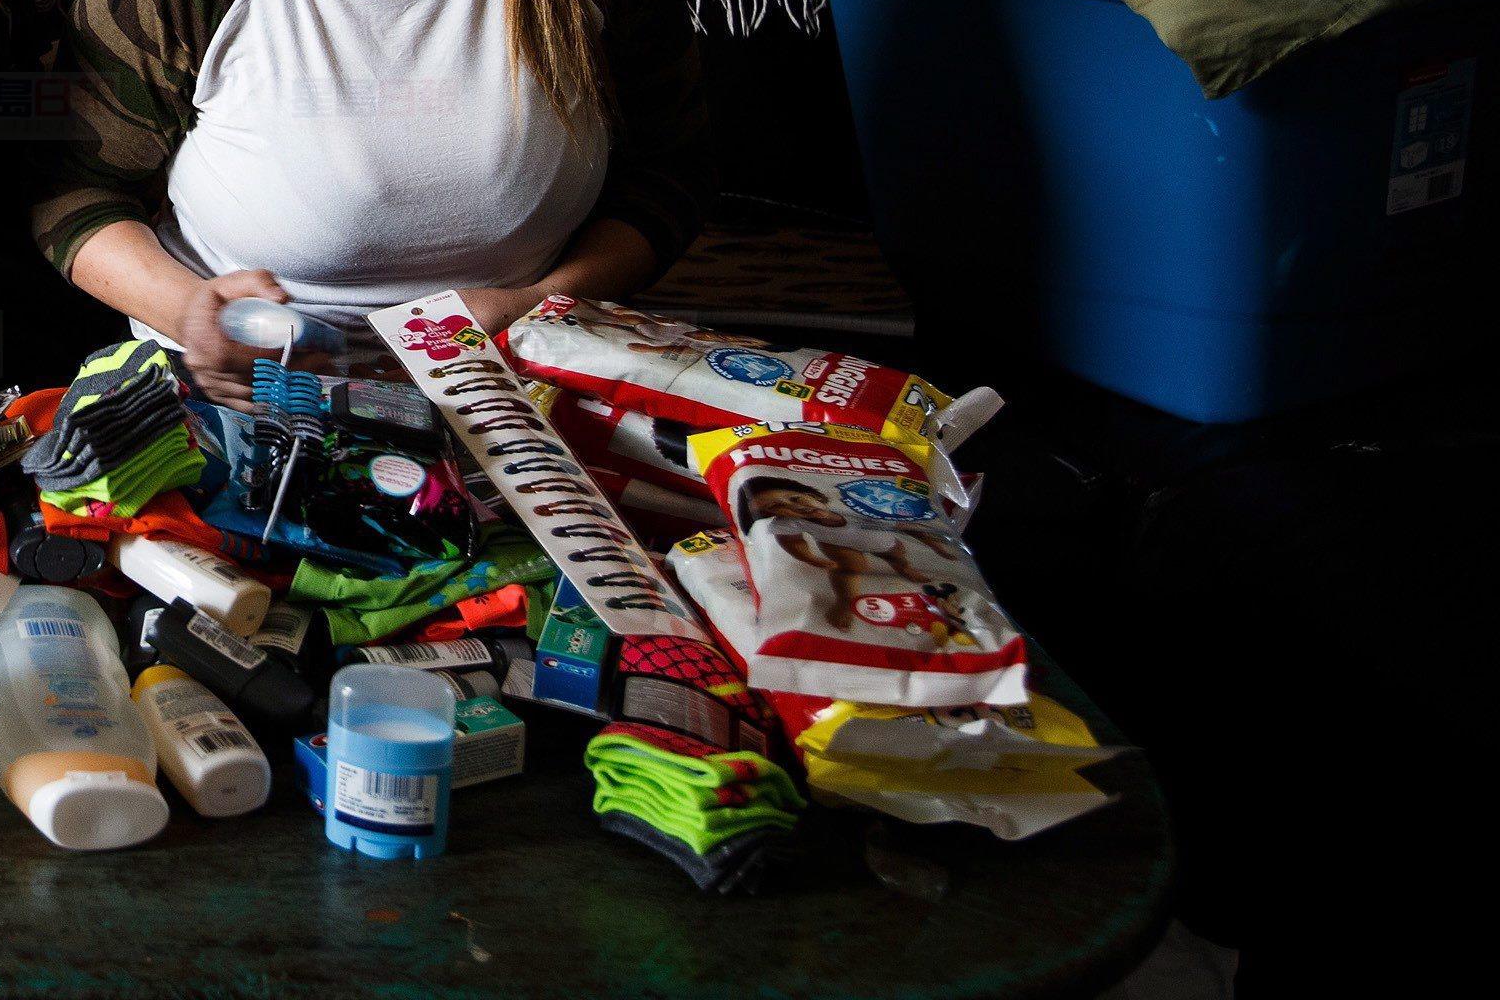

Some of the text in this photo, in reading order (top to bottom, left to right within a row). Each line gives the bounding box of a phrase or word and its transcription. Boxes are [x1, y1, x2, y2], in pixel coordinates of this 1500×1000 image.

[424, 325, 446, 333] Hair
[428, 330, 453, 338] Clips
[400, 333, 416, 343] 12
[820, 354, 882, 409] HUGGIES
[735, 429, 752, 438] TO
[729, 444, 910, 474] HUGGIES
[901, 596, 916, 609] 3
